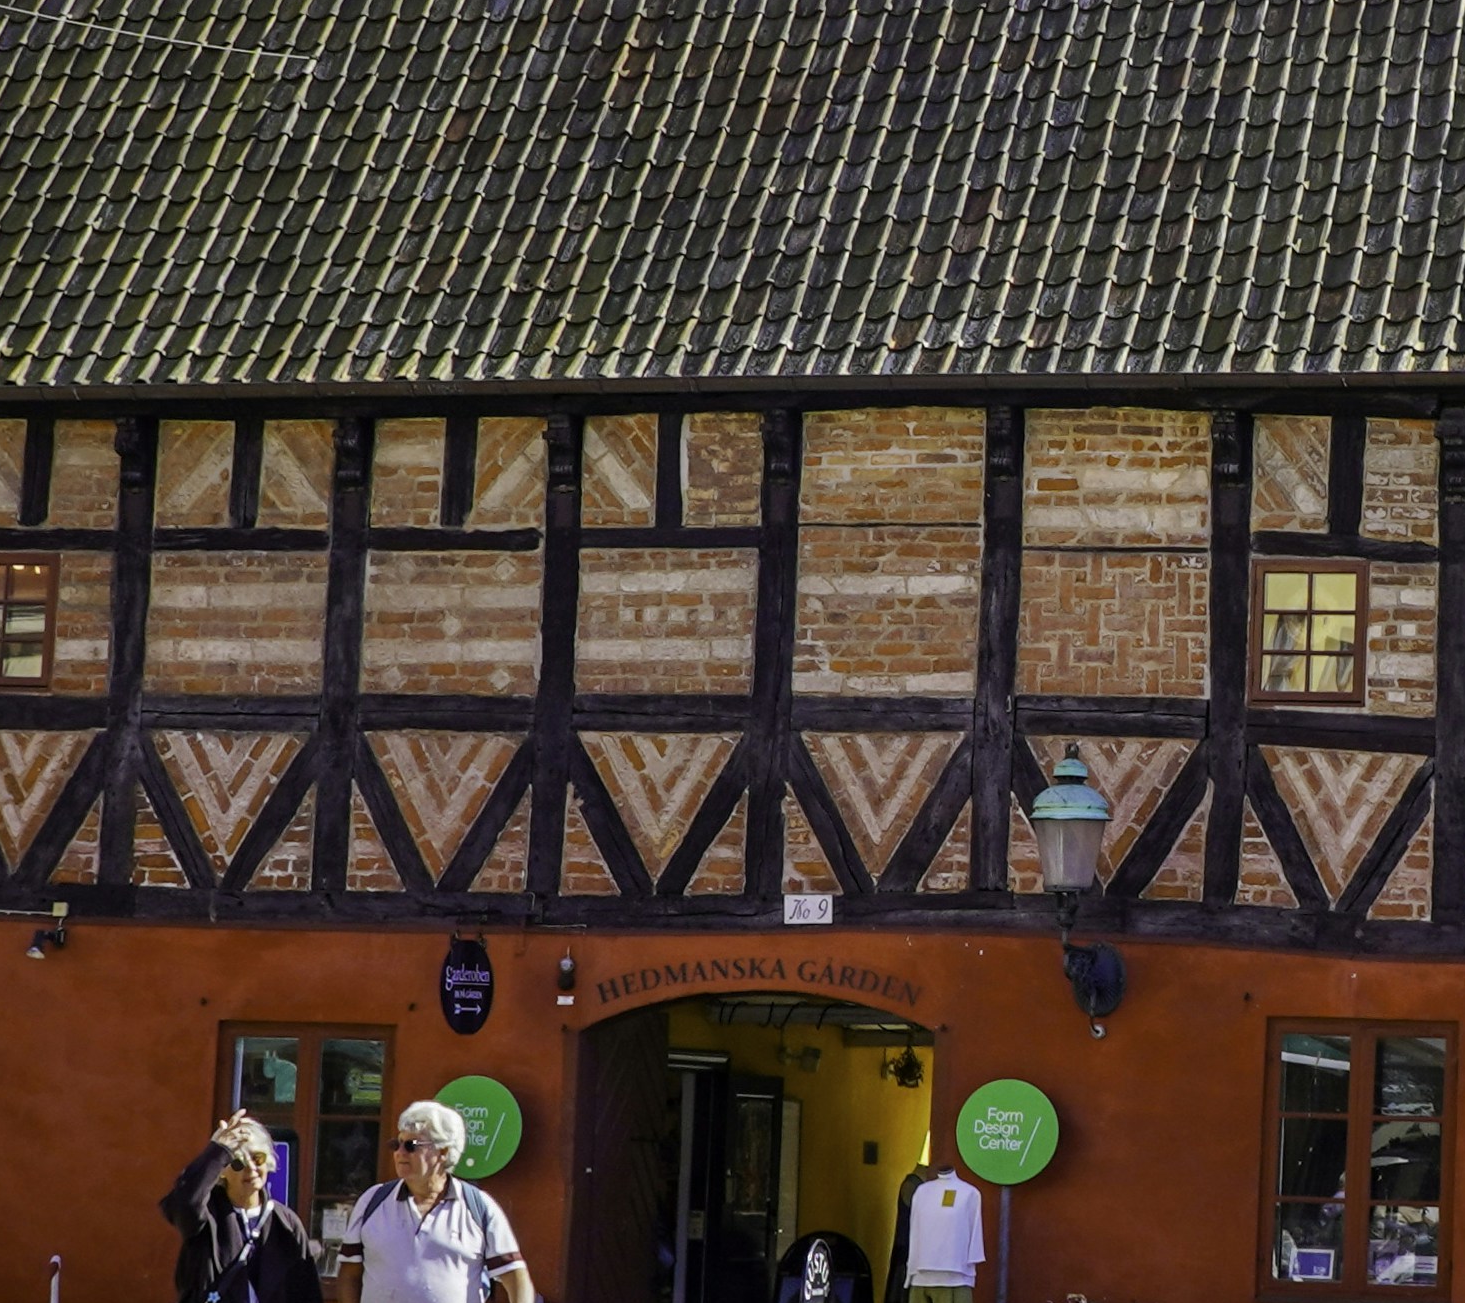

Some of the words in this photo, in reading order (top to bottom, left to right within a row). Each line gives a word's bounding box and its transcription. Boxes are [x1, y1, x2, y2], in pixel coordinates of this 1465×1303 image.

[817, 898, 829, 919] 9
[596, 957, 786, 1005] HEDMANSKA
[796, 957, 926, 1006] GÅRDEN
[987, 1107, 1024, 1122] Form
[974, 1119, 1020, 1138] Design
[979, 1134, 1024, 1151] Center
